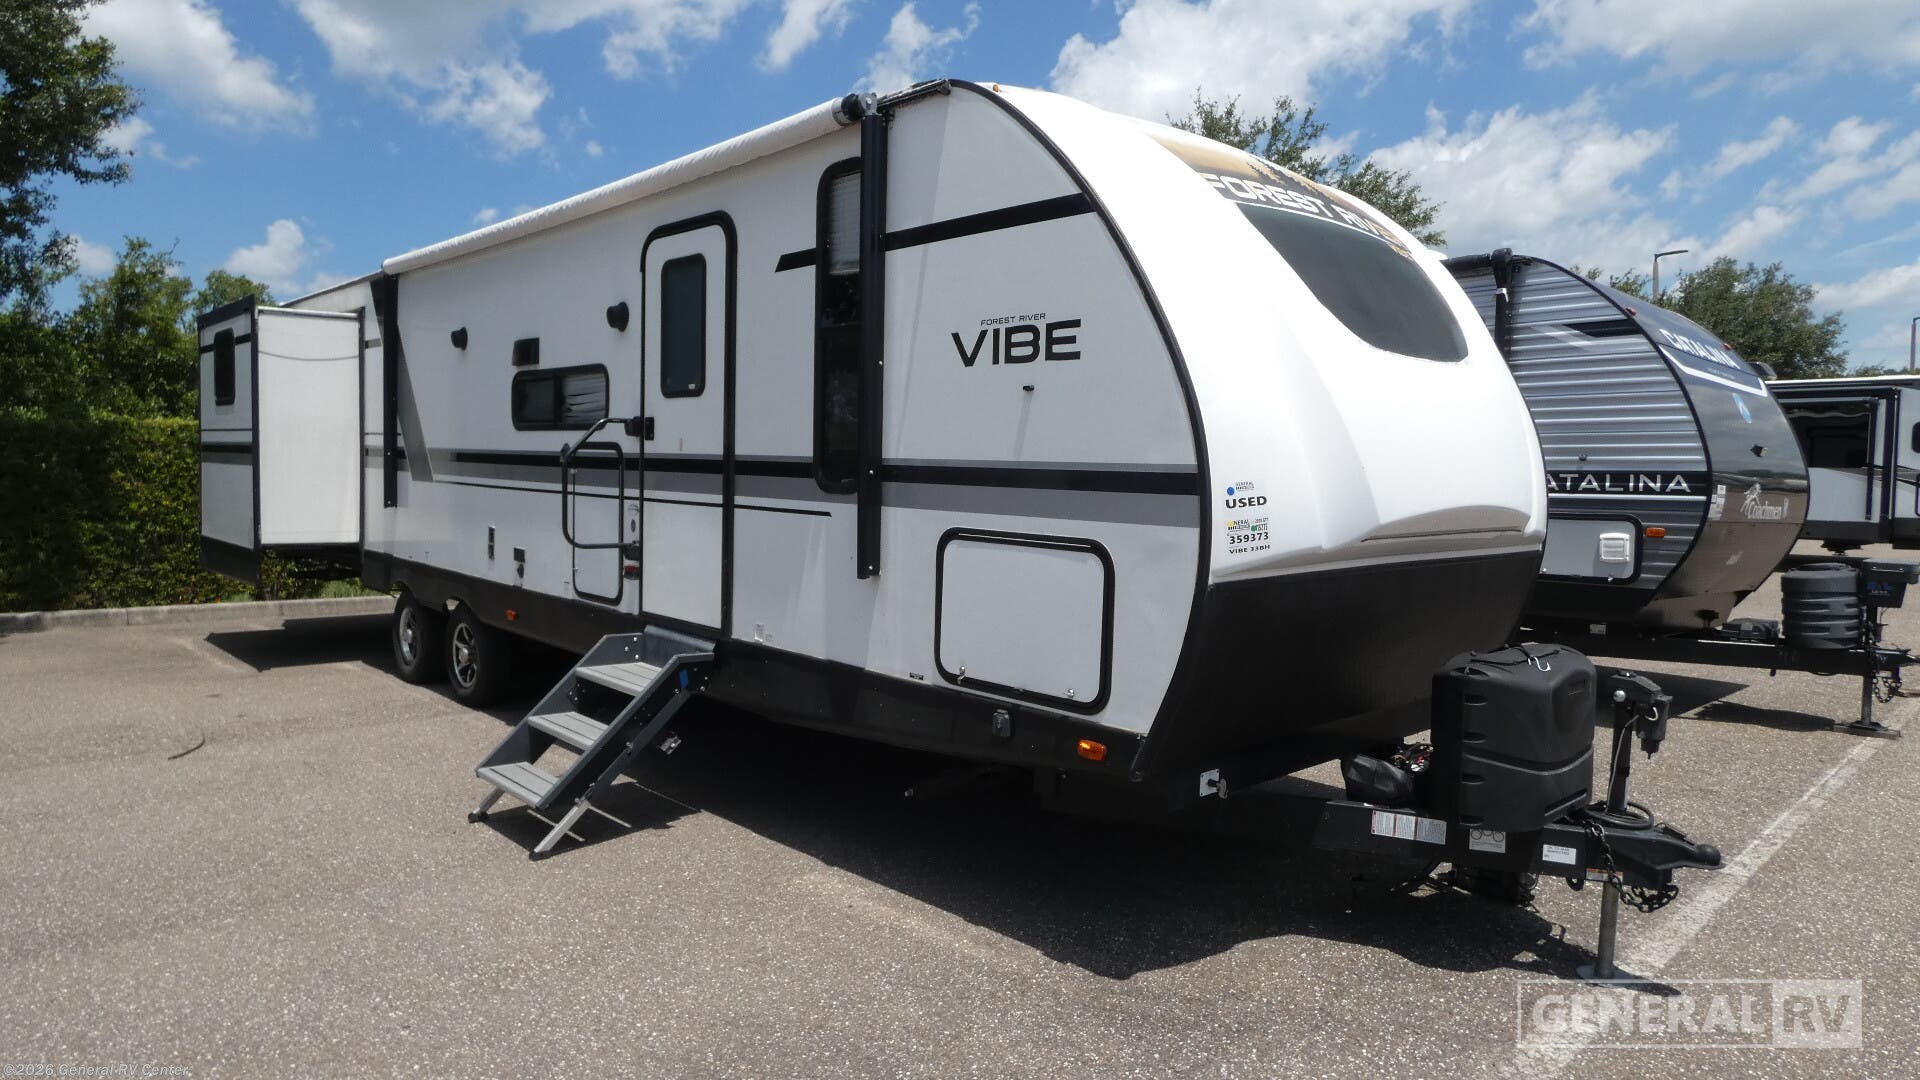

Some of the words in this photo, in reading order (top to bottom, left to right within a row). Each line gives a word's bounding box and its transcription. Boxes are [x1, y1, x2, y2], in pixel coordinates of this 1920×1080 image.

[1202, 173, 1333, 217] FOREST
[981, 316, 1016, 326] FOREST
[1018, 313, 1046, 322] RIVER
[951, 318, 1082, 367] VIBE
[1546, 473, 1692, 493] ATALINA
[1225, 496, 1268, 509] USED
[1229, 531, 1269, 545] 359373
